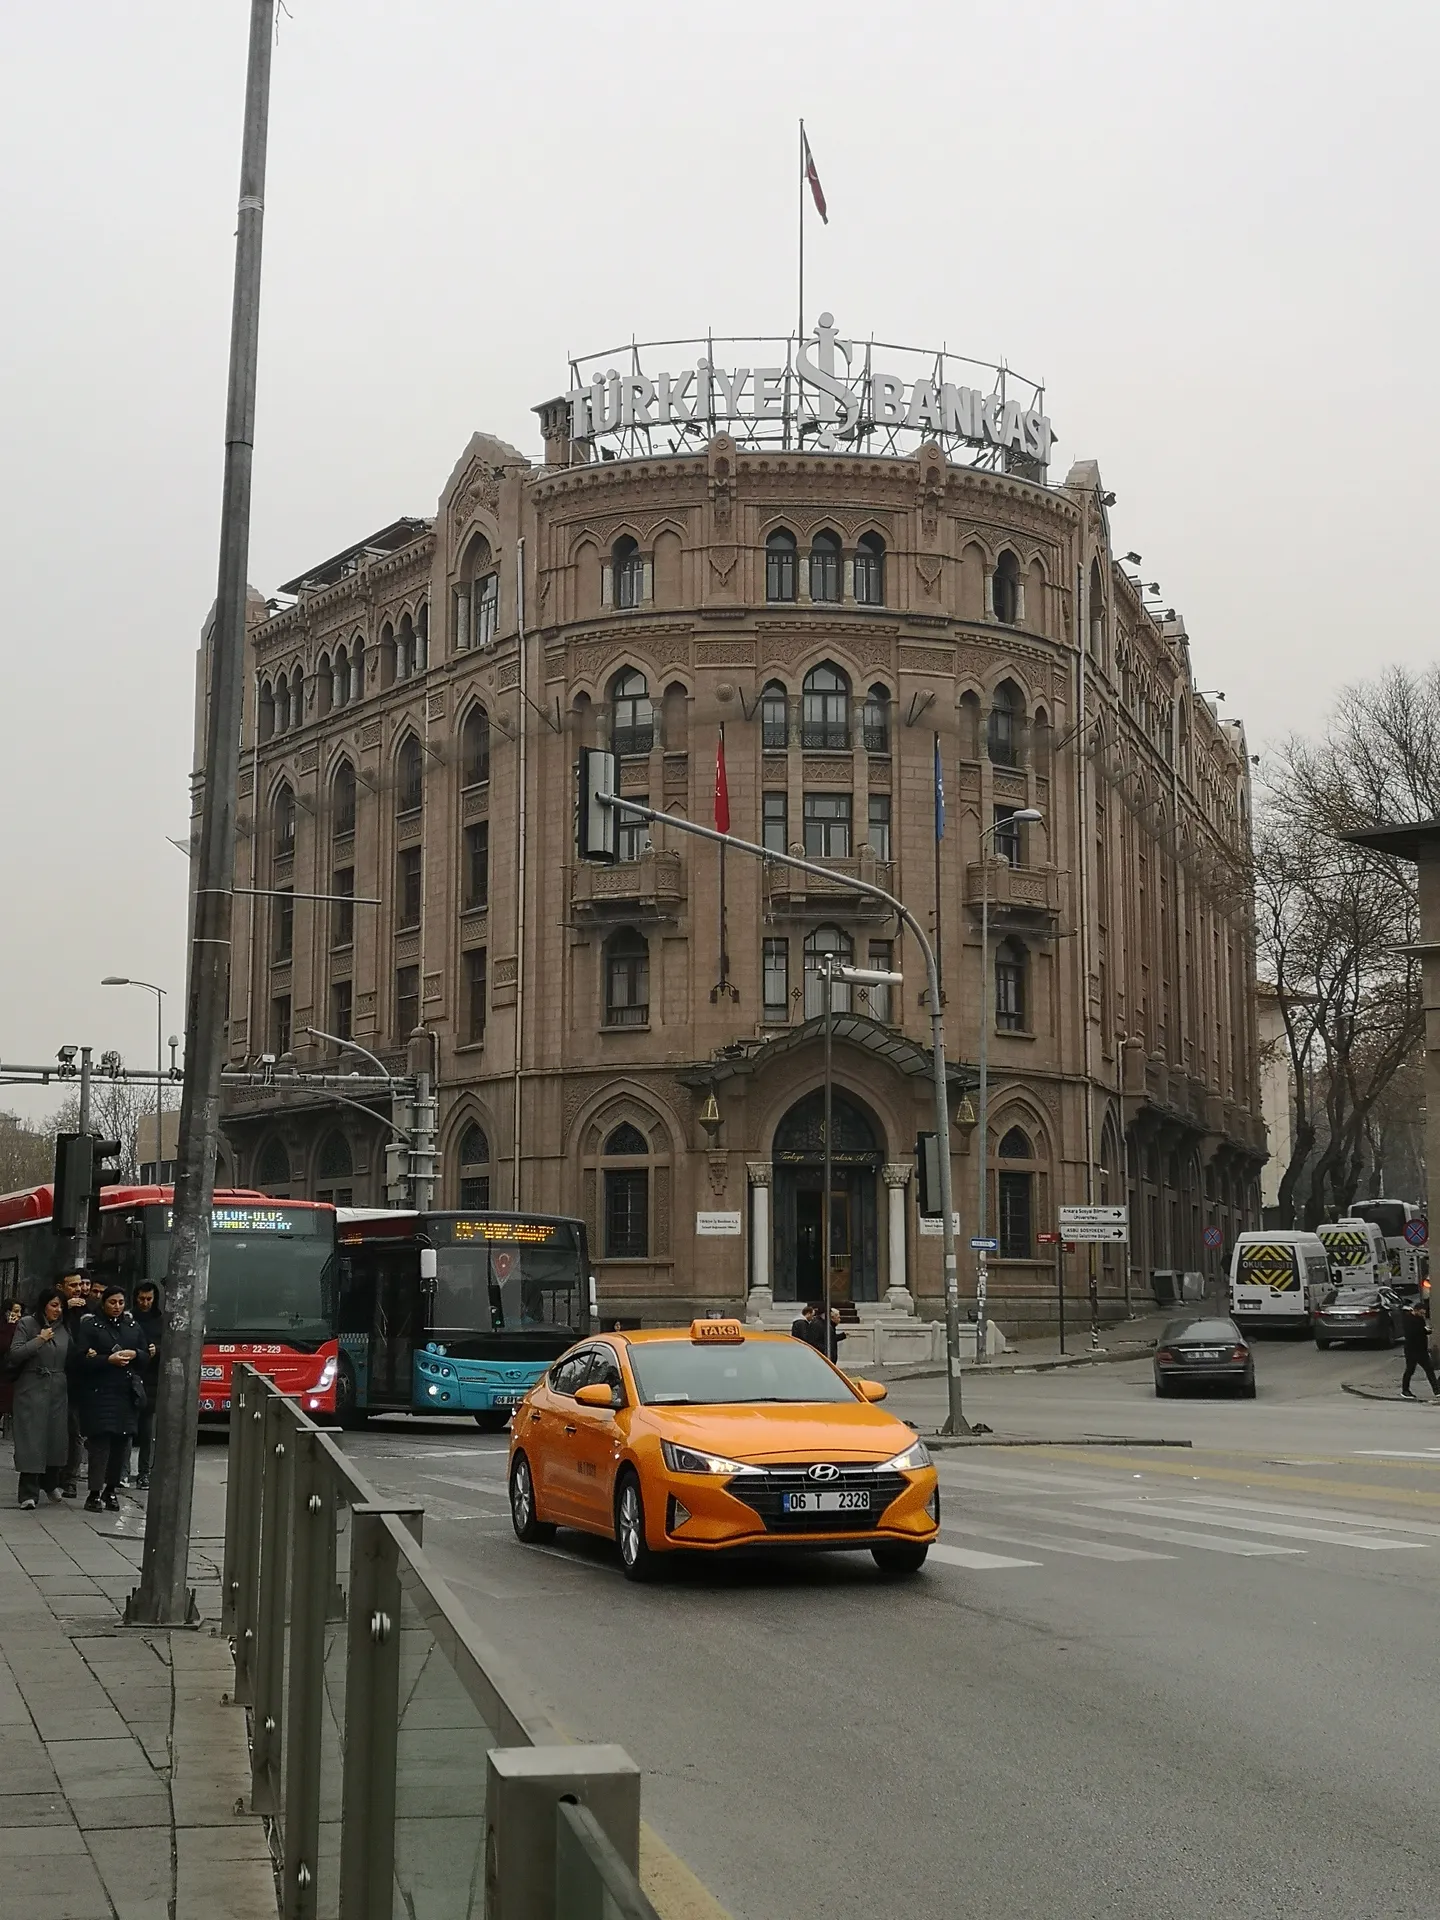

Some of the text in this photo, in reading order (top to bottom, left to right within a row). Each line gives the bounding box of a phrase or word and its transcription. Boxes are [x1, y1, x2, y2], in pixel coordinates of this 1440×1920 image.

[565, 357, 782, 442] TÜRKİYE
[871, 373, 1051, 466] BANKASI
[1242, 1260, 1265, 1269] OKUL
[219, 1344, 236, 1353] EGO
[252, 1344, 281, 1354] 22-229
[201, 1367, 222, 1377] EGO
[790, 1493, 806, 1509] 06
[814, 1493, 822, 1509] T
[838, 1492, 869, 1509] 2328
